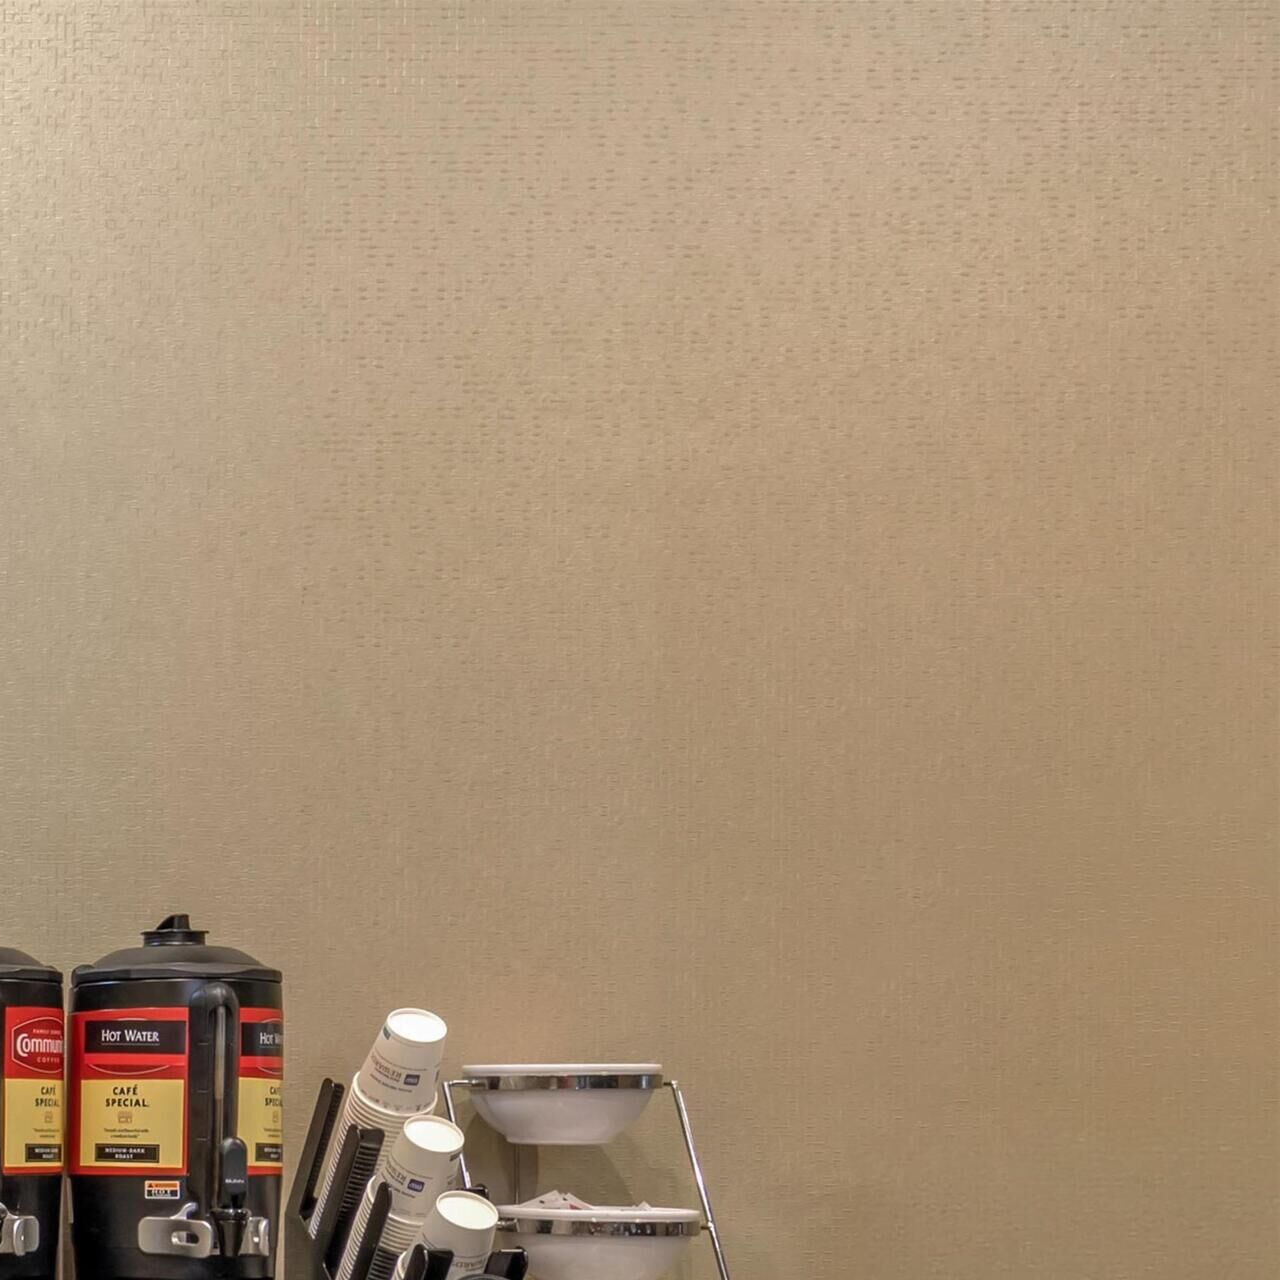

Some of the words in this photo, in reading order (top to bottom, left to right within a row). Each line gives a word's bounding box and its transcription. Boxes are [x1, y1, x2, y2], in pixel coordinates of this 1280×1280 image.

[101, 1029, 121, 1042] HOT
[124, 1029, 160, 1042] WATER
[112, 1084, 138, 1096] CAFÉ
